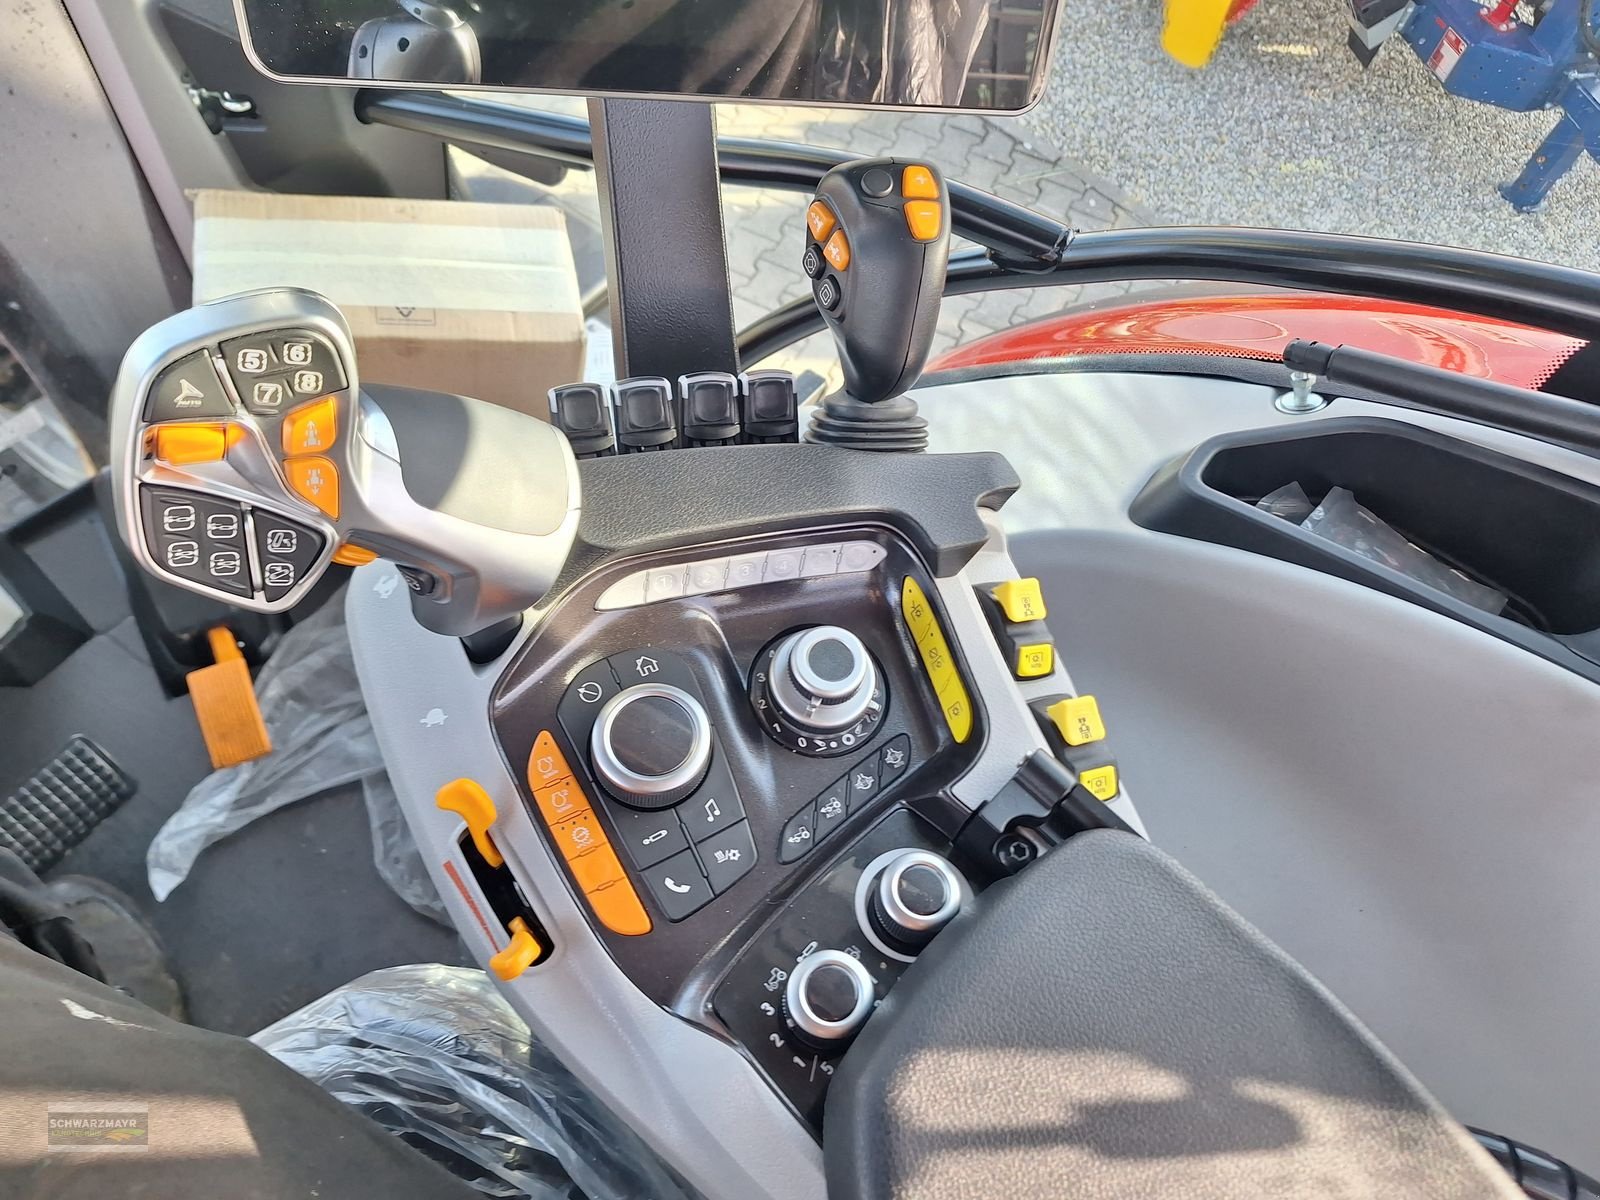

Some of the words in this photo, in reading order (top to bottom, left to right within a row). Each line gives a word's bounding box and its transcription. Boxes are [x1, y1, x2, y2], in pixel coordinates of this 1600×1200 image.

[245, 353, 260, 369] 5
[290, 345, 304, 362] 6
[260, 386, 273, 402] 7
[301, 374, 315, 390] 8
[757, 673, 766, 682] 3
[758, 700, 767, 709] 2
[773, 723, 781, 732] 1
[760, 1002, 775, 1016] 3
[769, 1033, 784, 1048] 2
[793, 1056, 806, 1068] 1
[820, 1061, 834, 1075] 5
